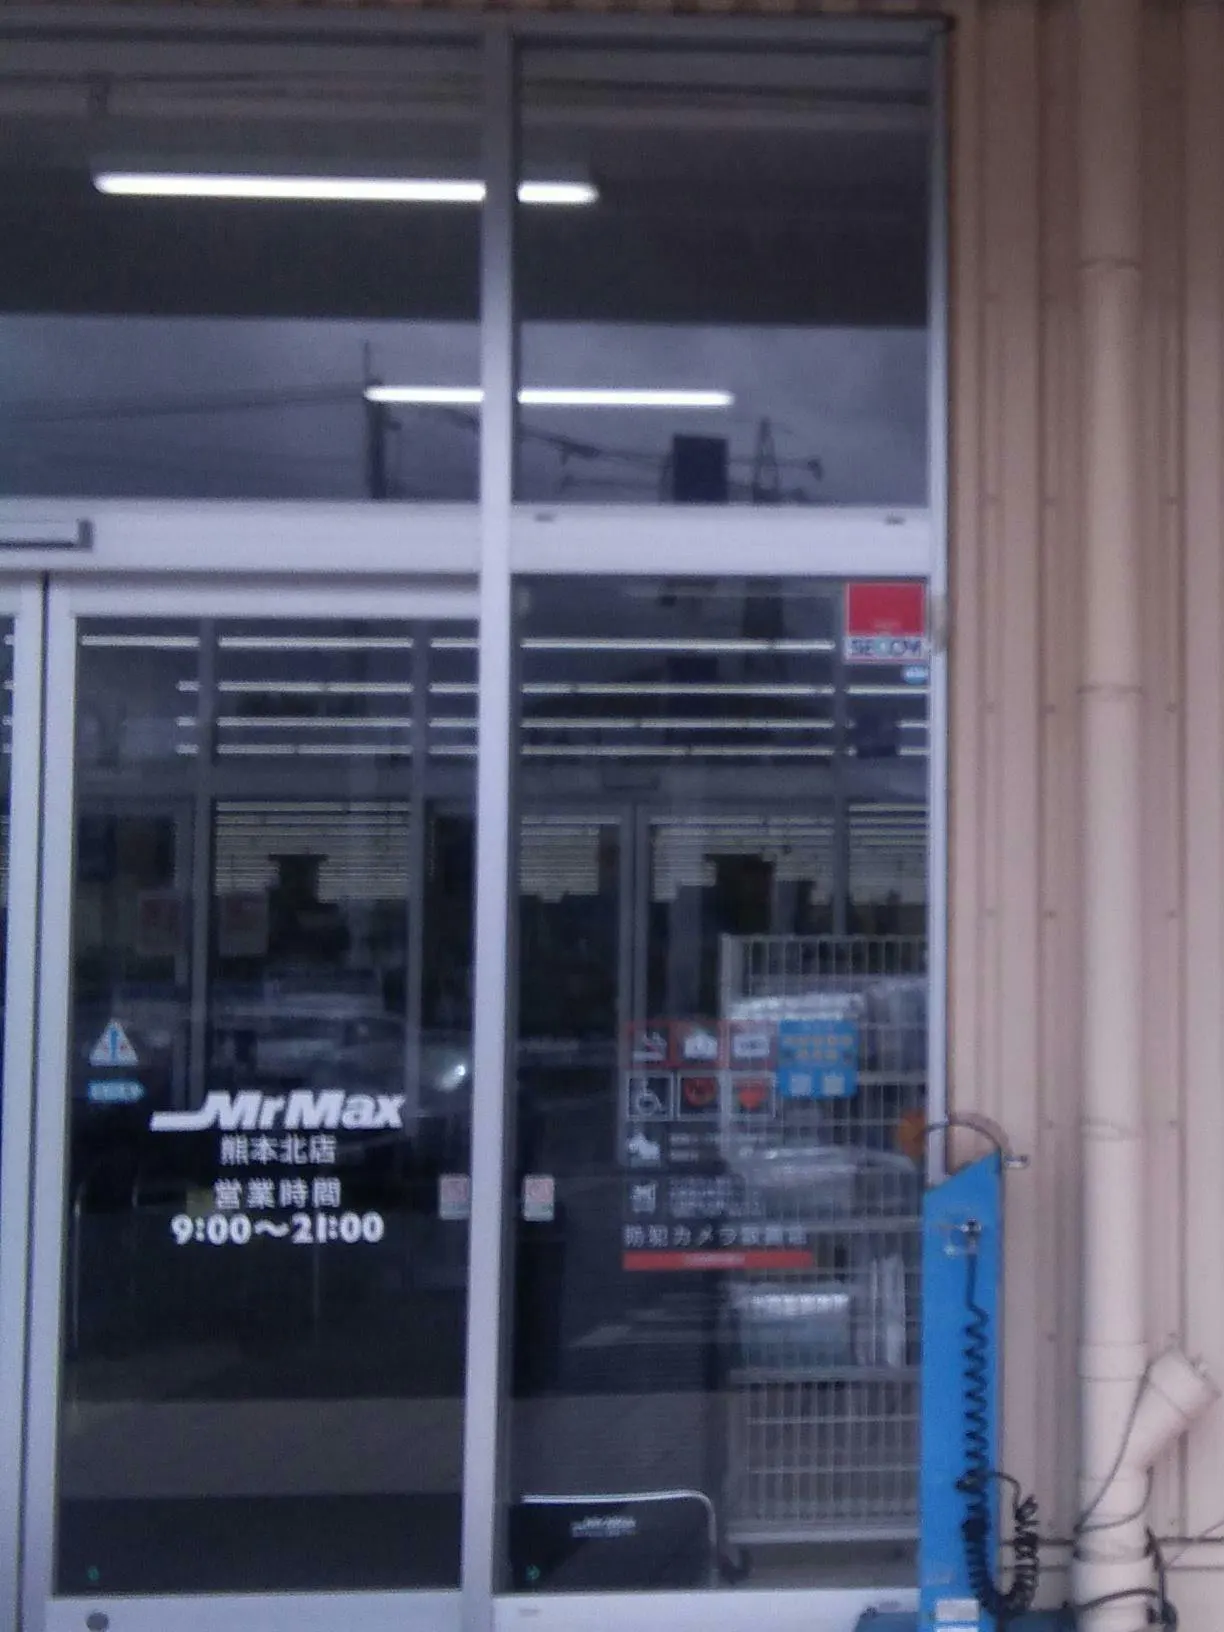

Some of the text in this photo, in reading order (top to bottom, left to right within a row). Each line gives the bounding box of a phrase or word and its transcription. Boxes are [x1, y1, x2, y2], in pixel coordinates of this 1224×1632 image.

[151, 1090, 406, 1131] MrMax
[220, 1134, 337, 1165] 熊本北店
[213, 1178, 342, 1209] 営業時間
